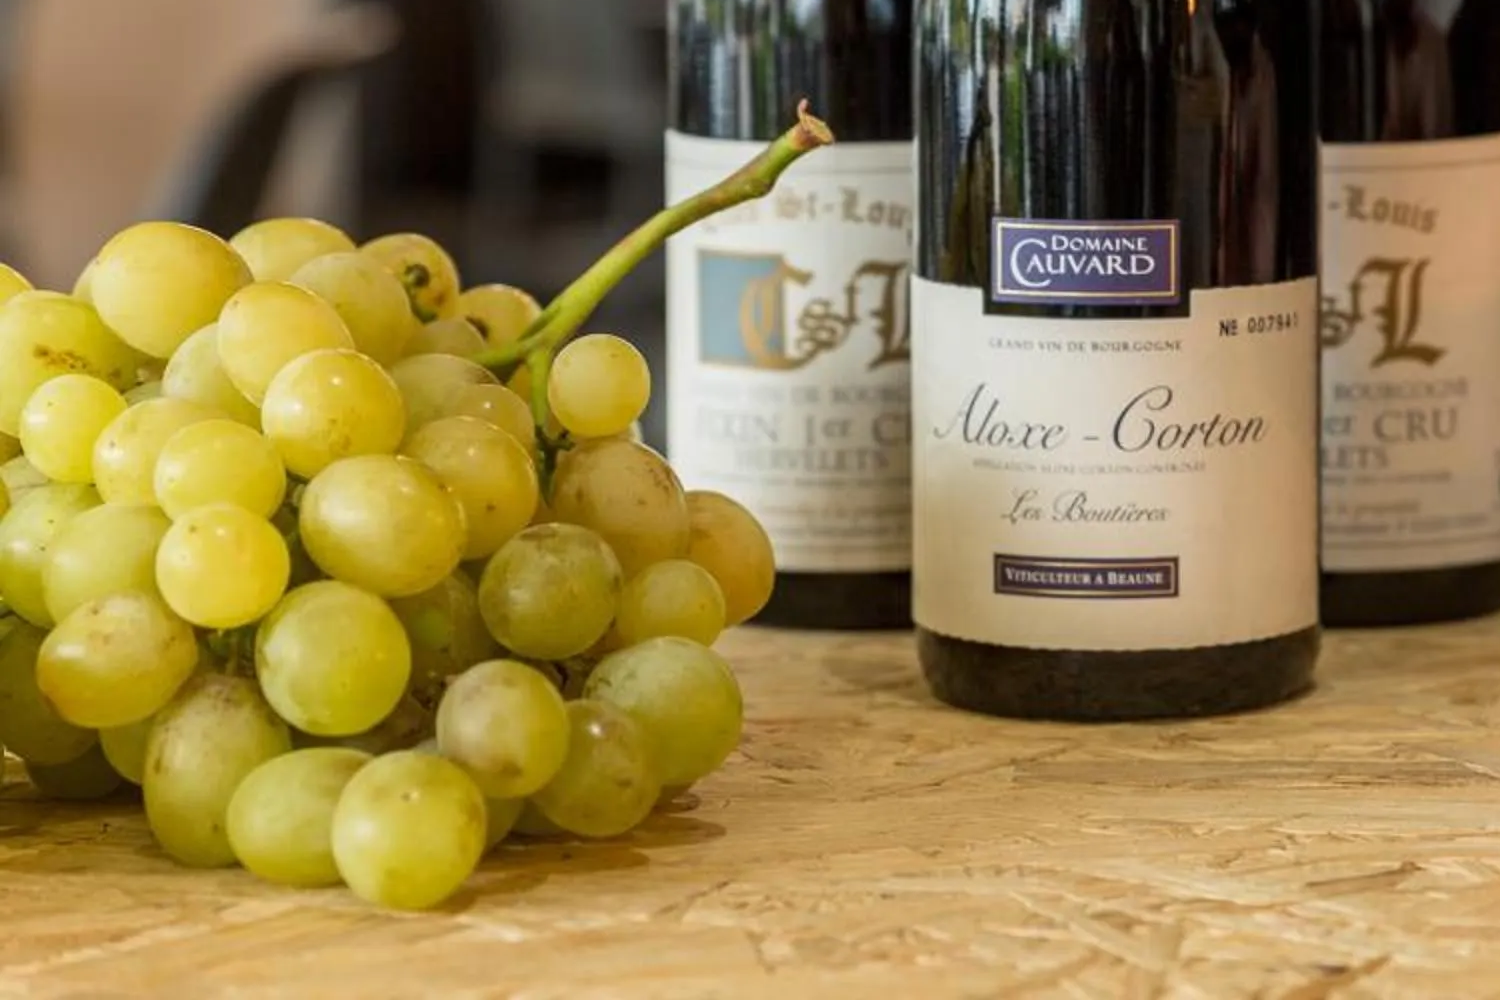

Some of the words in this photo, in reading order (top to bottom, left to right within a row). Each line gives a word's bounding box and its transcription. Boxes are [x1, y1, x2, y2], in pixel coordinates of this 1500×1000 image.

[1052, 234, 1148, 251] DOMAINE
[1010, 238, 1155, 288] CAUVARD
[1037, 340, 1062, 351] VIN
[1066, 341, 1086, 352] DE
[1090, 340, 1183, 352] BOURGOGNE
[1113, 384, 1267, 452] Corton
[1372, 407, 1458, 443] CRU
[1005, 567, 1092, 585] VITICULTEUR
[1107, 571, 1164, 585] BEAUNE
